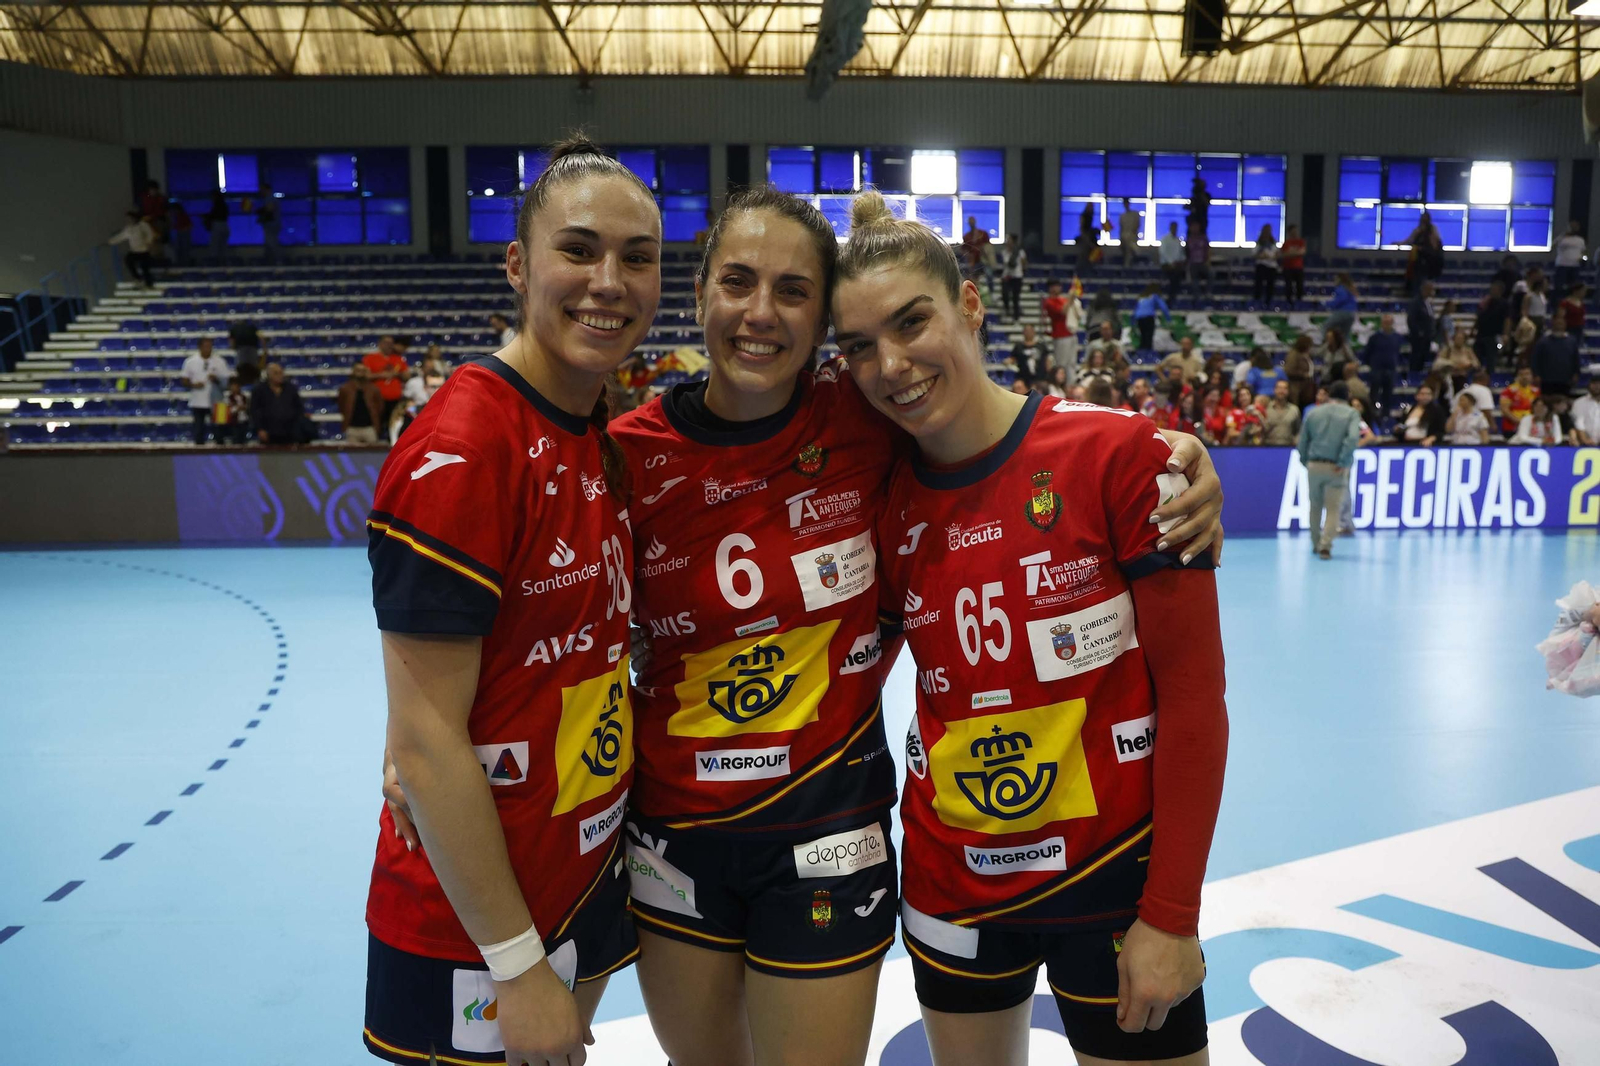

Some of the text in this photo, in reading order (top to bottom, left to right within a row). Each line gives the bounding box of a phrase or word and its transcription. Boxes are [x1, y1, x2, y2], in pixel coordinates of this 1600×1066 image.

[720, 480, 768, 502] Ceuta
[827, 489, 860, 503] DÓLMENES
[1277, 448, 1550, 529] AGECIRAS
[819, 498, 861, 515] ANTEQUERA
[798, 520, 836, 536] PATRIMONIO
[961, 526, 1003, 548] Ceuta
[840, 545, 866, 562] GOBIERNO
[1063, 555, 1099, 571] DÓLMENES
[601, 534, 632, 621] 58
[637, 556, 690, 579] ntander
[715, 533, 764, 610] 6
[842, 563, 850, 571] de
[844, 562, 870, 580] CANTABRIA
[521, 561, 601, 596] Santander
[1035, 584, 1100, 606] PATRIMONIO MUNDIAL
[903, 610, 940, 631] ntander
[955, 581, 1012, 667] 65
[1080, 612, 1118, 632] GOBIERNO
[524, 623, 594, 667] AVIS
[1083, 629, 1122, 651] CANTABRIA
[1066, 653, 1094, 666] CONSEJERÍA
[1100, 643, 1118, 654] CULTURA
[1073, 659, 1093, 669] TURISMO
[1097, 651, 1115, 662] DEPORTE
[984, 694, 1009, 702] Iberdrola
[700, 753, 787, 773] VARGROUP
[848, 849, 881, 867] cantabria
[969, 844, 1063, 867] VARGROUP
